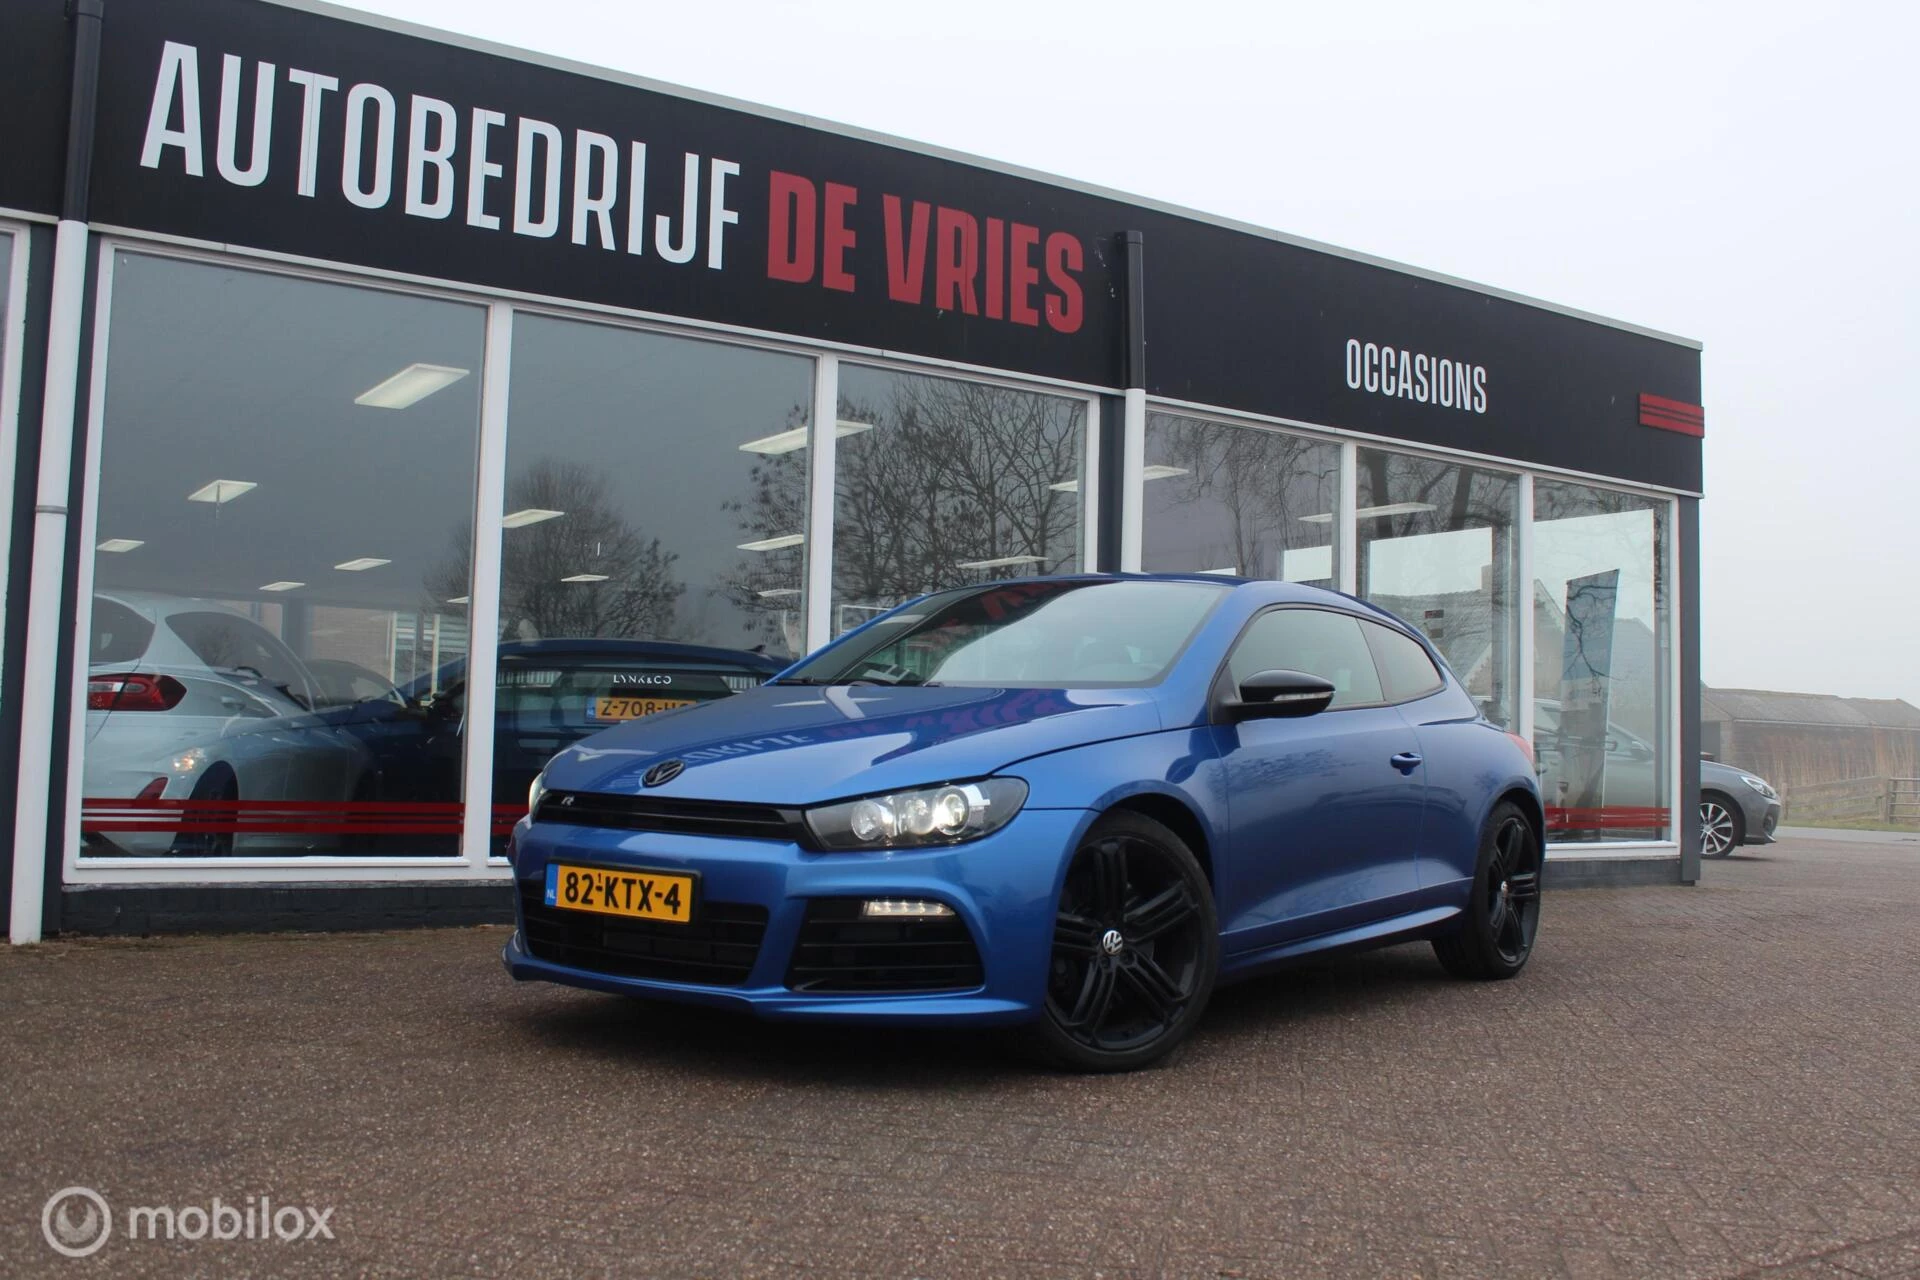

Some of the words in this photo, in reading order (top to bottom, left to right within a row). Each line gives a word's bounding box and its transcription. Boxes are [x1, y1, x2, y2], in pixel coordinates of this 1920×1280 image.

[139, 39, 741, 270] AUTOBEDRIJF
[767, 169, 858, 293] DE
[882, 193, 1084, 334] VRIES
[1346, 338, 1487, 414] OCCASIONS
[565, 871, 681, 915] 82-KTX-4
